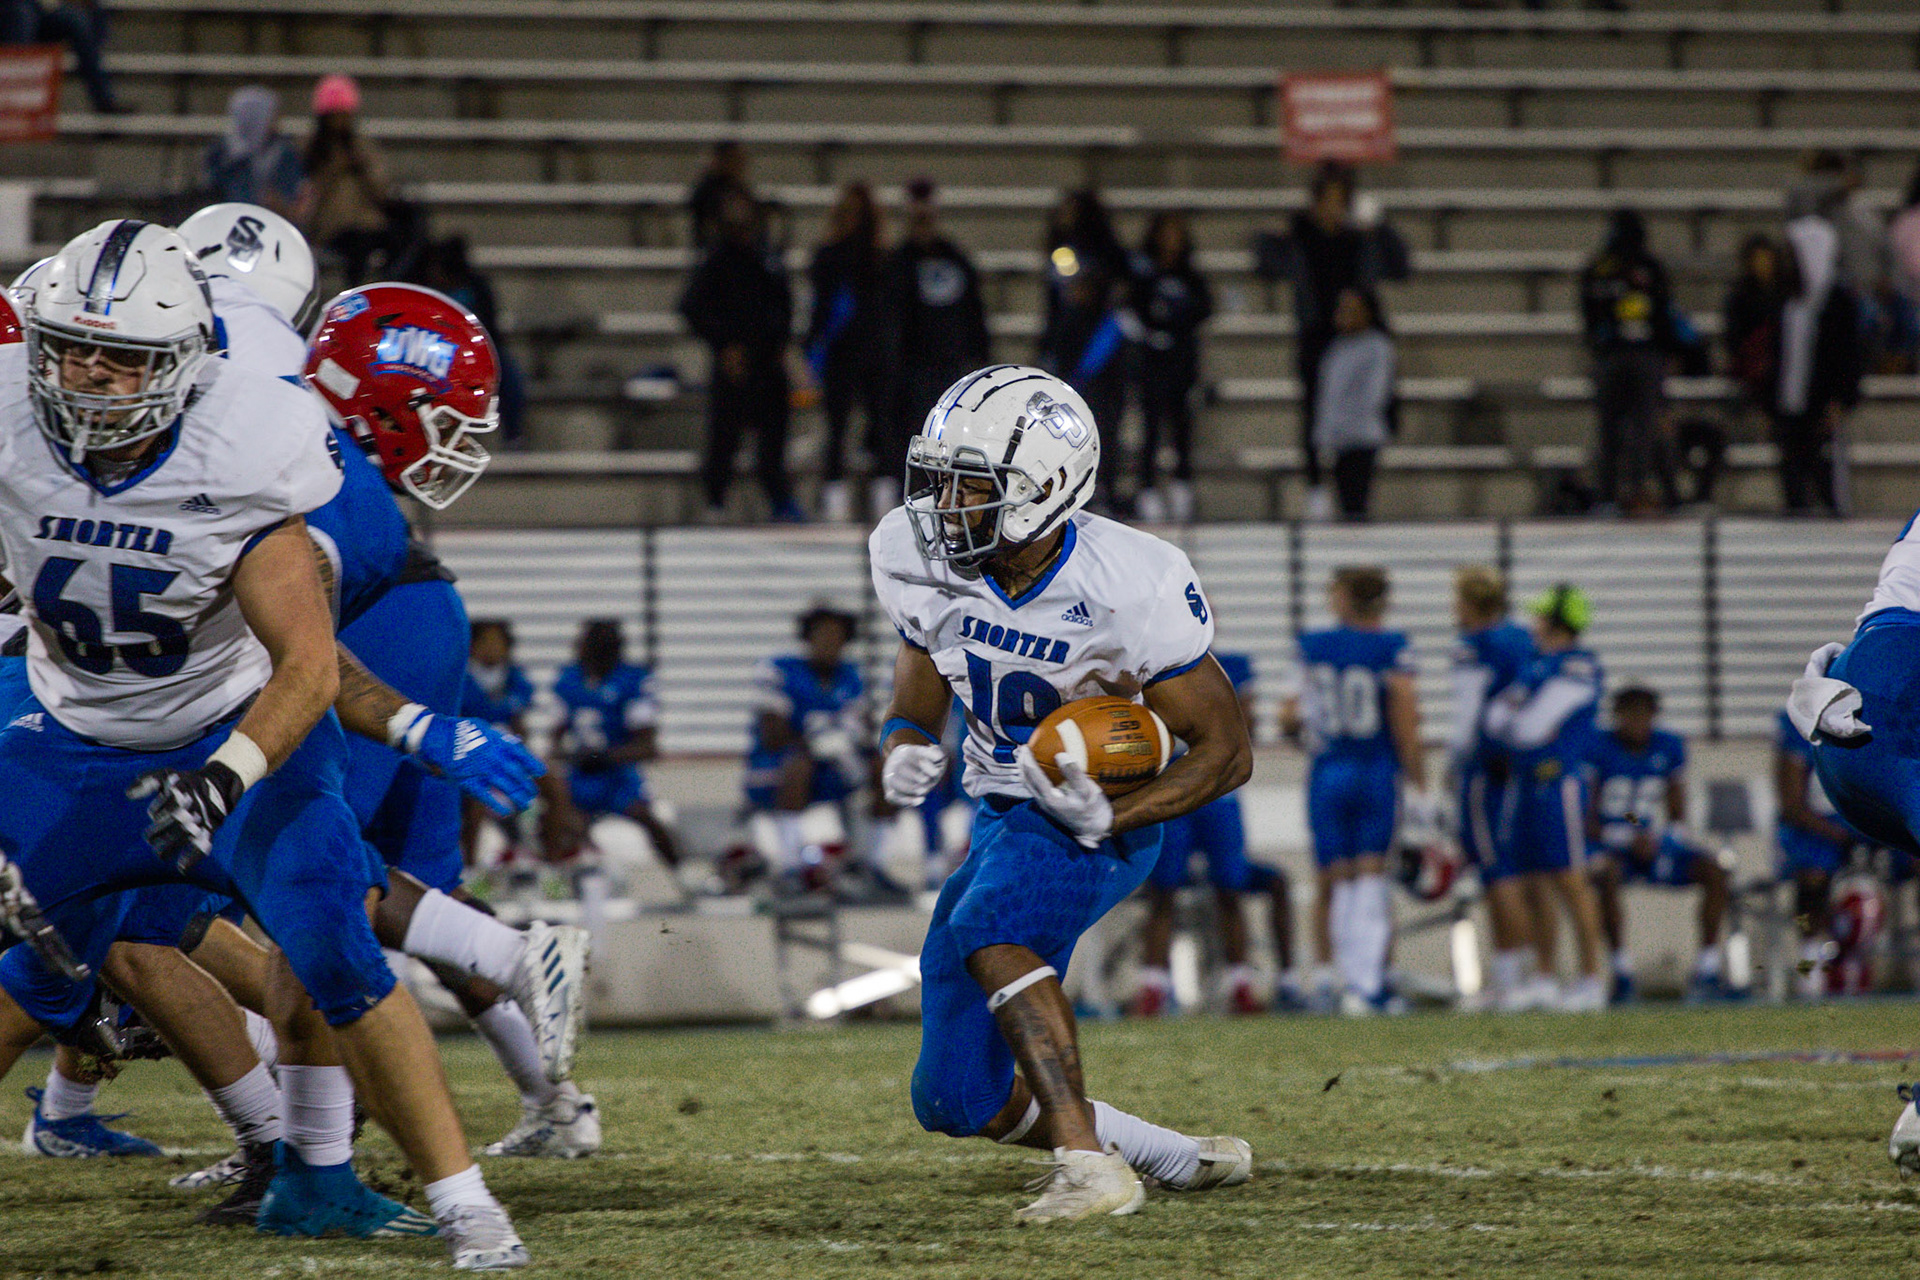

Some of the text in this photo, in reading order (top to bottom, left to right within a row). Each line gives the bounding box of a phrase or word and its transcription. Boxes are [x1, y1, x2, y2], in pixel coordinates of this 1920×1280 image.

[33, 515, 174, 555] SHORTER
[33, 556, 189, 677] 65
[1061, 613, 1094, 627] adidas
[958, 615, 1070, 664] SHORTER
